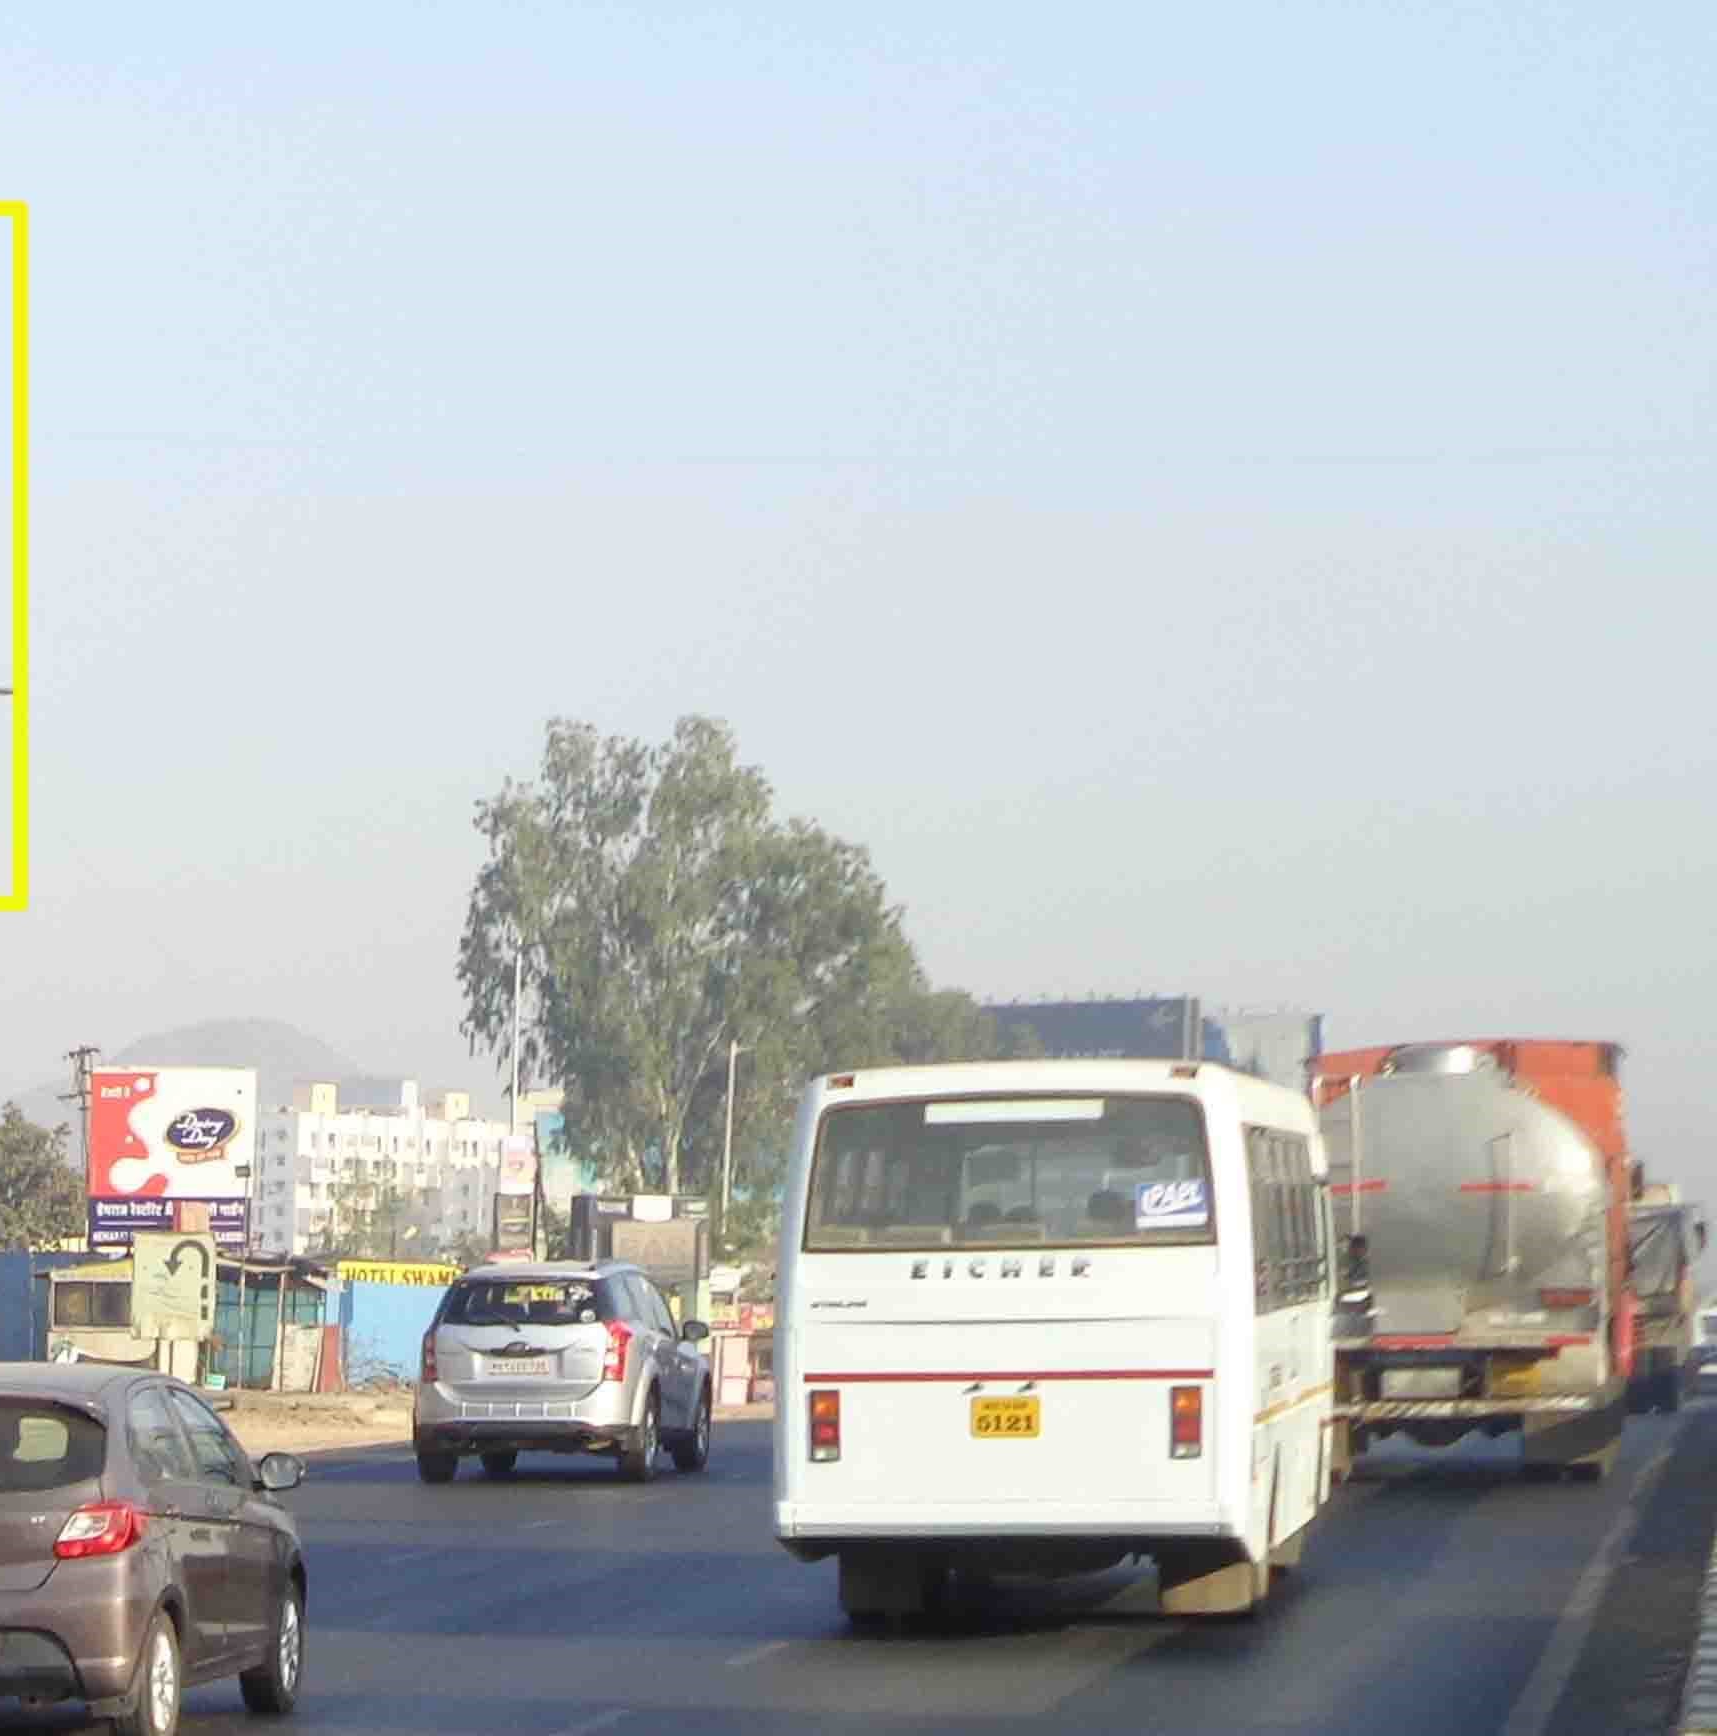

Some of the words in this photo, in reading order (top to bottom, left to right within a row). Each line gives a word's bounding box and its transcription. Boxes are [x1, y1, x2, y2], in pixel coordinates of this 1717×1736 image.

[176, 1113, 225, 1135] Dairy
[181, 1128, 218, 1150] Day
[346, 1267, 394, 1285] HOTEL
[910, 1257, 1091, 1280] EICHER
[976, 1415, 1031, 1432] 5121
